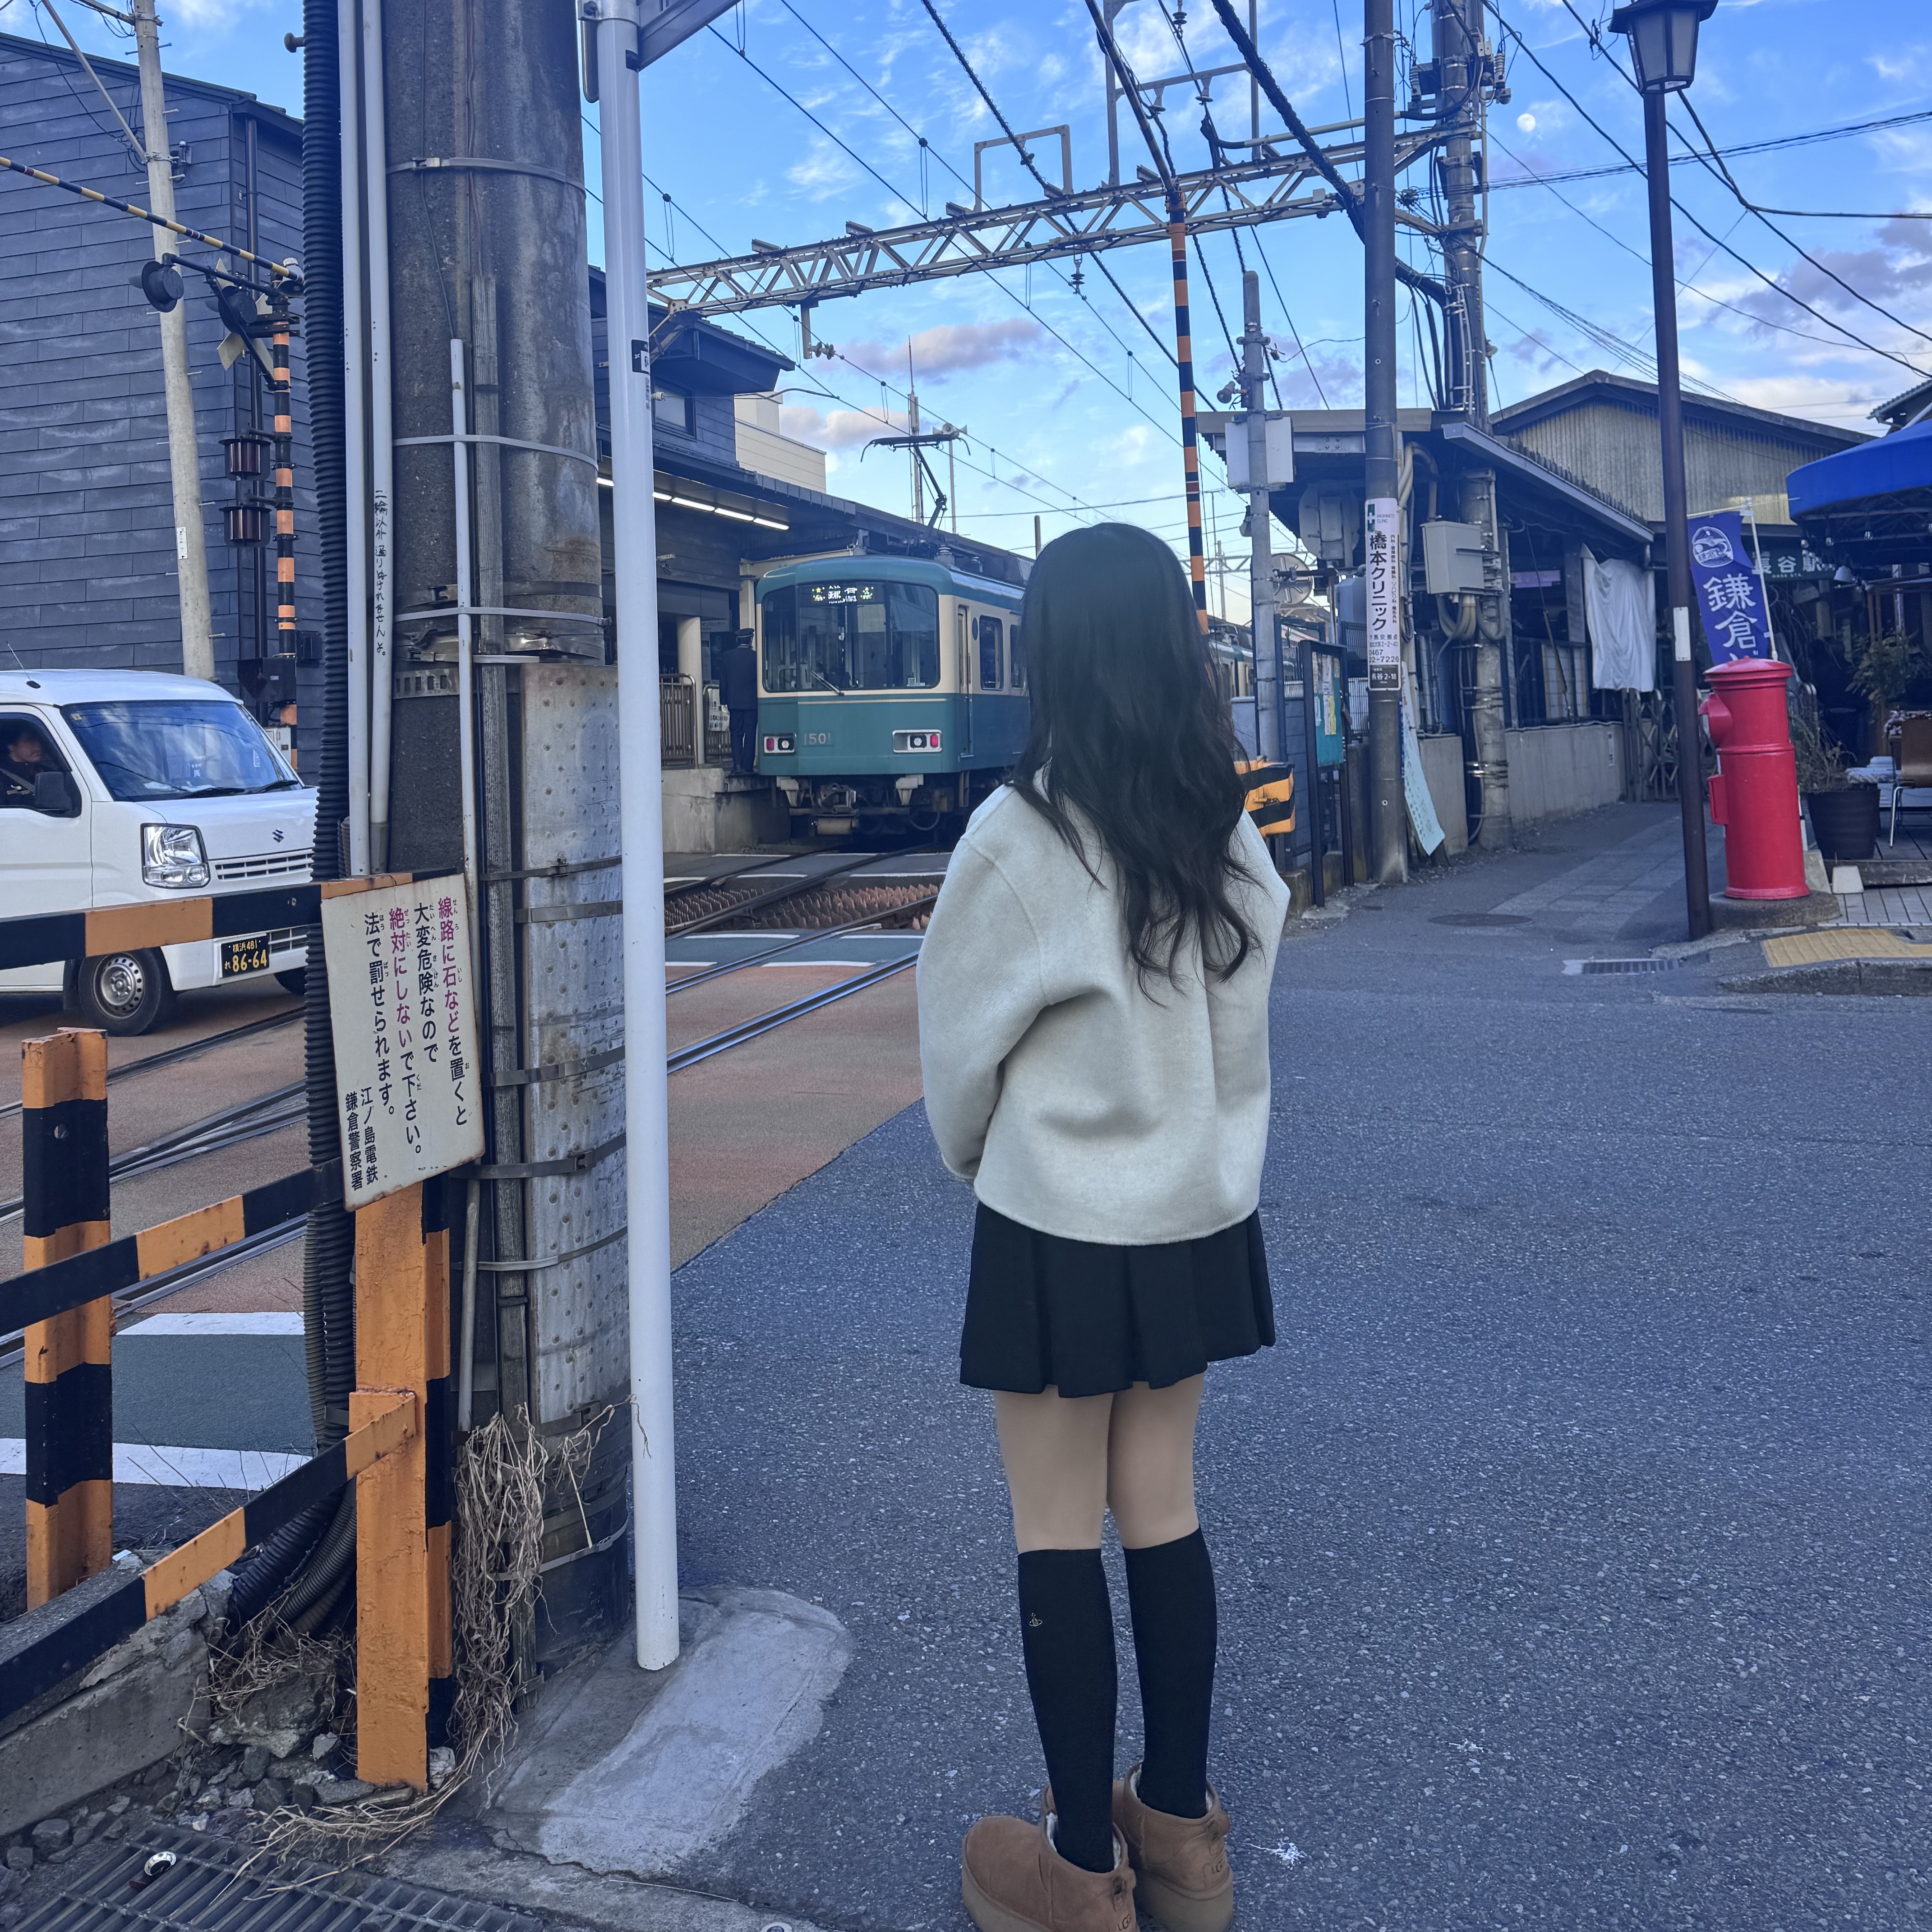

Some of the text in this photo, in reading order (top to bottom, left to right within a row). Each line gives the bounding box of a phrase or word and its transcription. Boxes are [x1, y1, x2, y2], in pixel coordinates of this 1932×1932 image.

[1369, 534, 1388, 631] 橋本クリニック
[1702, 573, 1759, 661] 鎌倉
[232, 949, 267, 972] 86-64
[414, 902, 438, 1063] 大変危険なので
[438, 896, 467, 1126] 線路に石などを置くと
[364, 912, 395, 1115] 法で罰せられます。
[389, 907, 421, 1154] 絶対にしないで下さい。
[345, 1090, 363, 1191] 鎌倉警察署
[360, 1086, 378, 1185] 江ノ島電鉄
